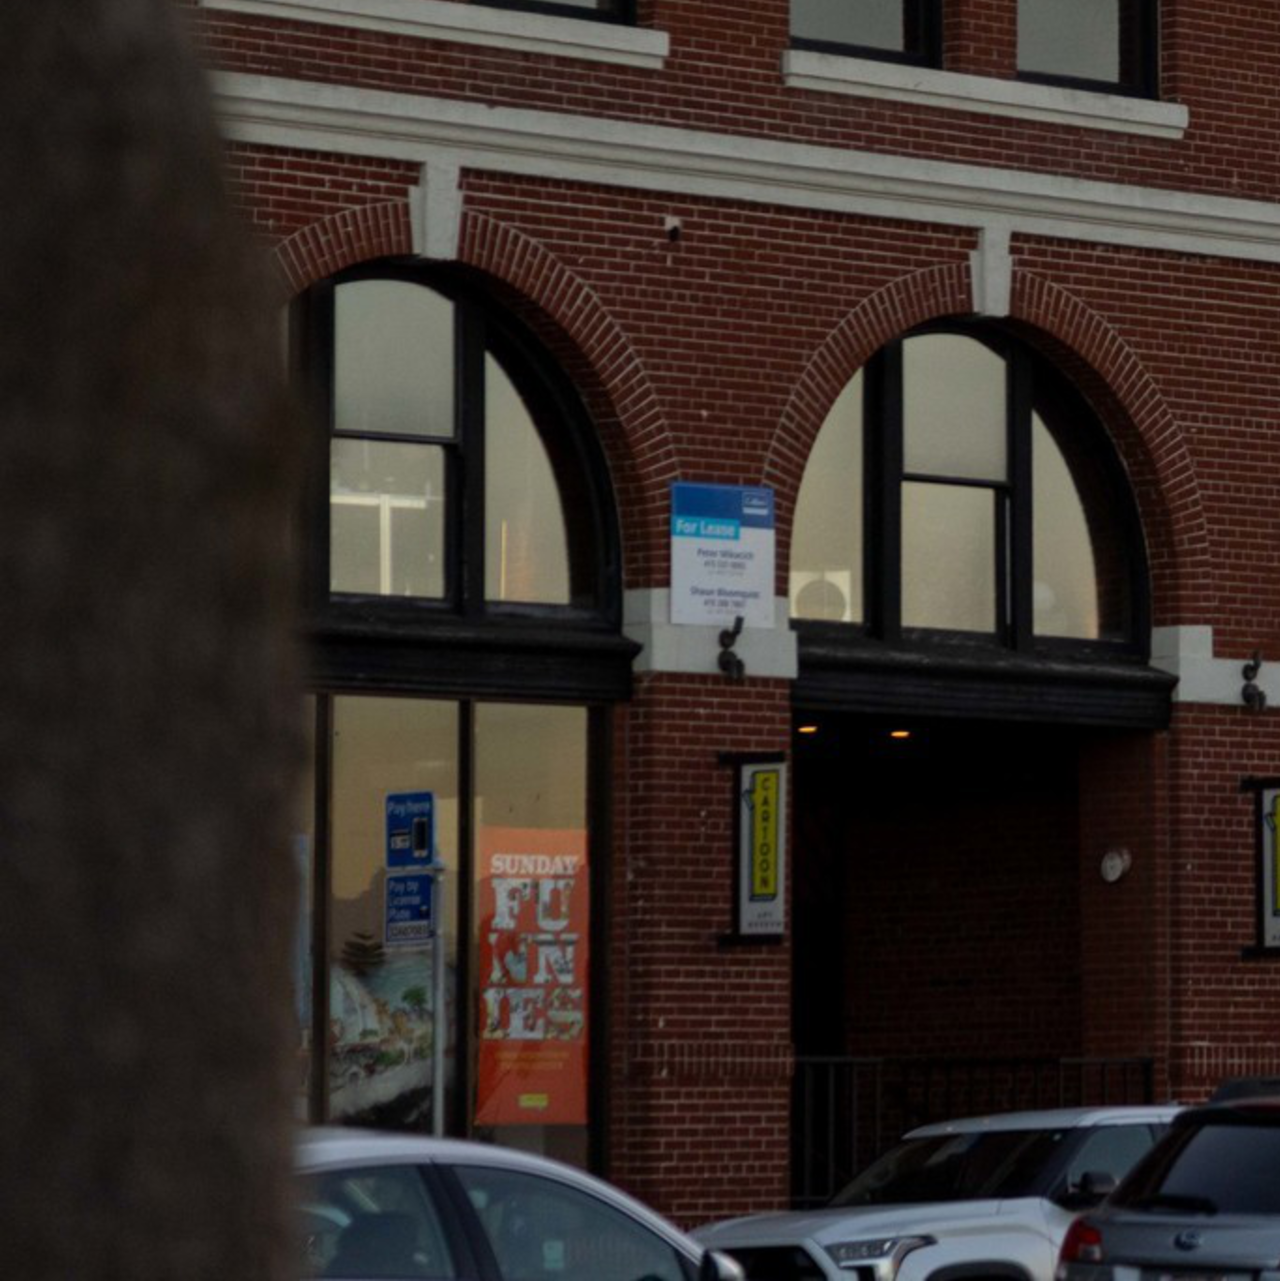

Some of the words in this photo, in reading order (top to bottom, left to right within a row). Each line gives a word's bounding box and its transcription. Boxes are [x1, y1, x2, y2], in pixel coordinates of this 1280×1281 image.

[675, 519, 698, 534] For
[700, 520, 736, 537] Lease
[759, 778, 771, 889] CARTOON
[490, 853, 579, 876] SUNDAY
[491, 877, 575, 932] FU
[482, 987, 583, 1041] IES
